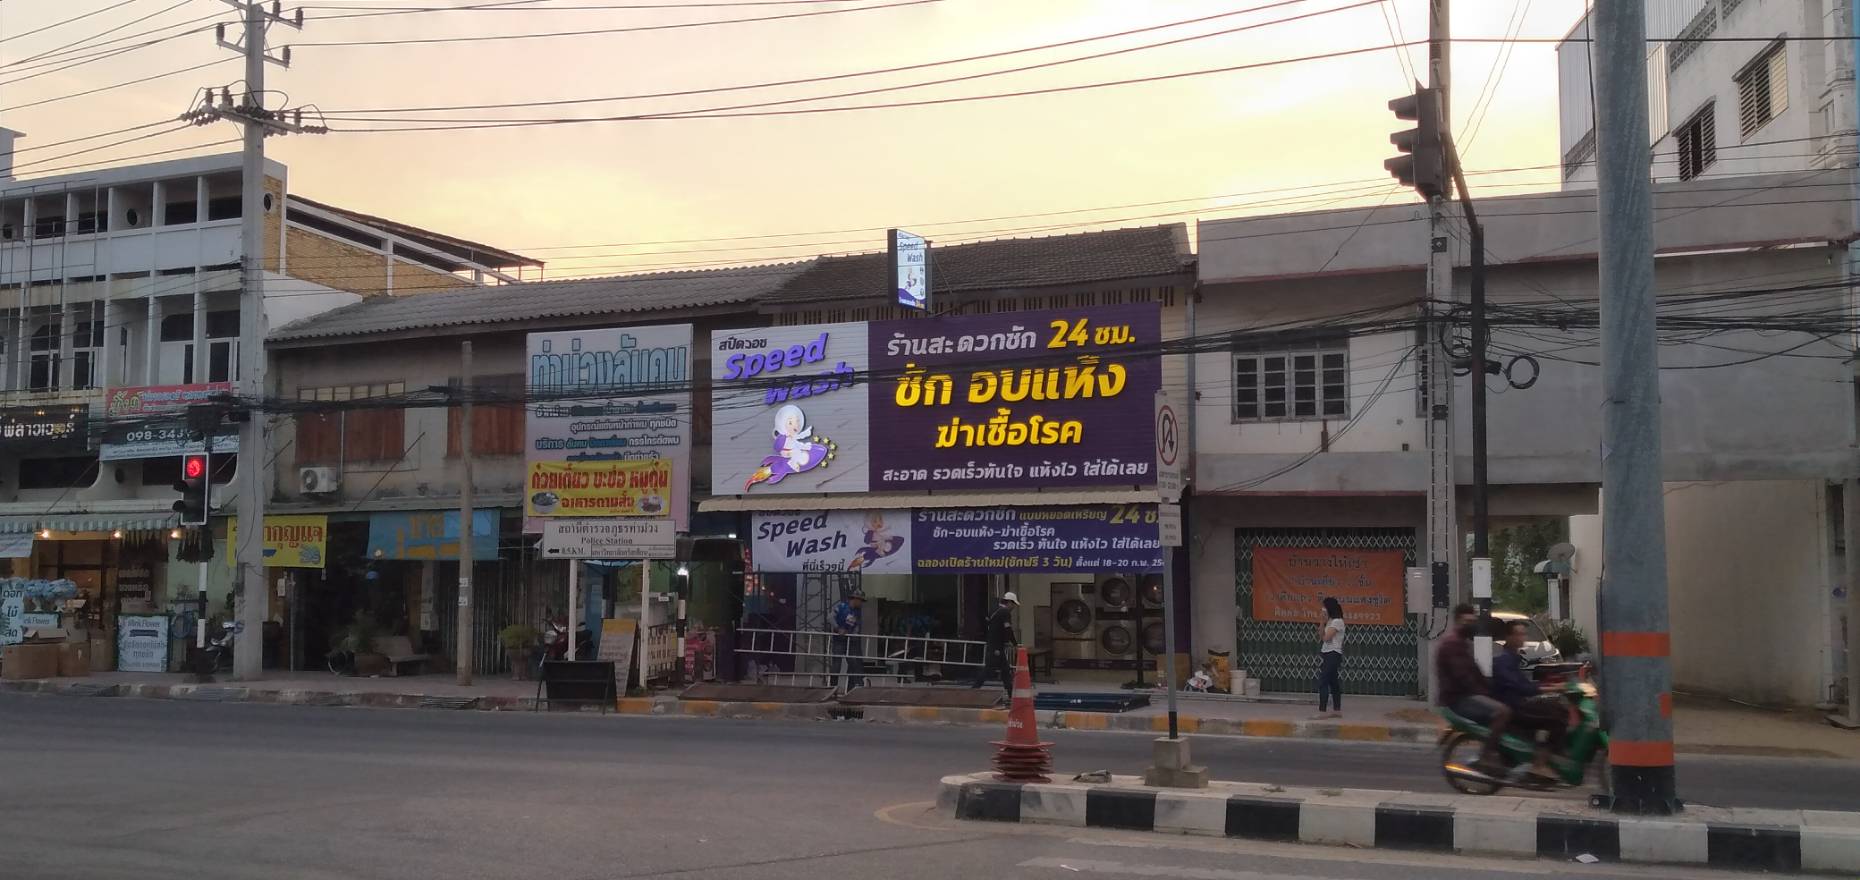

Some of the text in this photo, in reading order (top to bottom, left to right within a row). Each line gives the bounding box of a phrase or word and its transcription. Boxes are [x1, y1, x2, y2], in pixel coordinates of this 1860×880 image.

[718, 336, 768, 351] สปีดวอช
[1047, 318, 1089, 349] 24
[1094, 324, 1136, 345] ชม.
[722, 332, 829, 380] Speed
[967, 354, 1127, 404] อบแห้ง
[935, 407, 1083, 448] ฆ่าเชื้อโรค
[882, 467, 928, 481] สะอาด
[932, 462, 1024, 481] รวดเร็วทันใจ
[1028, 460, 1078, 478] แห้งไว
[1083, 457, 1149, 477] ใส่ได้เลย
[756, 510, 829, 542] Speed
[1109, 505, 1141, 524] 24
[580, 536, 633, 545] Police Station
[786, 530, 848, 558] Wash
[993, 537, 1034, 551] รวดเร็ว
[1038, 537, 1067, 550] ทันใจ
[1071, 537, 1108, 550] แห้งไว
